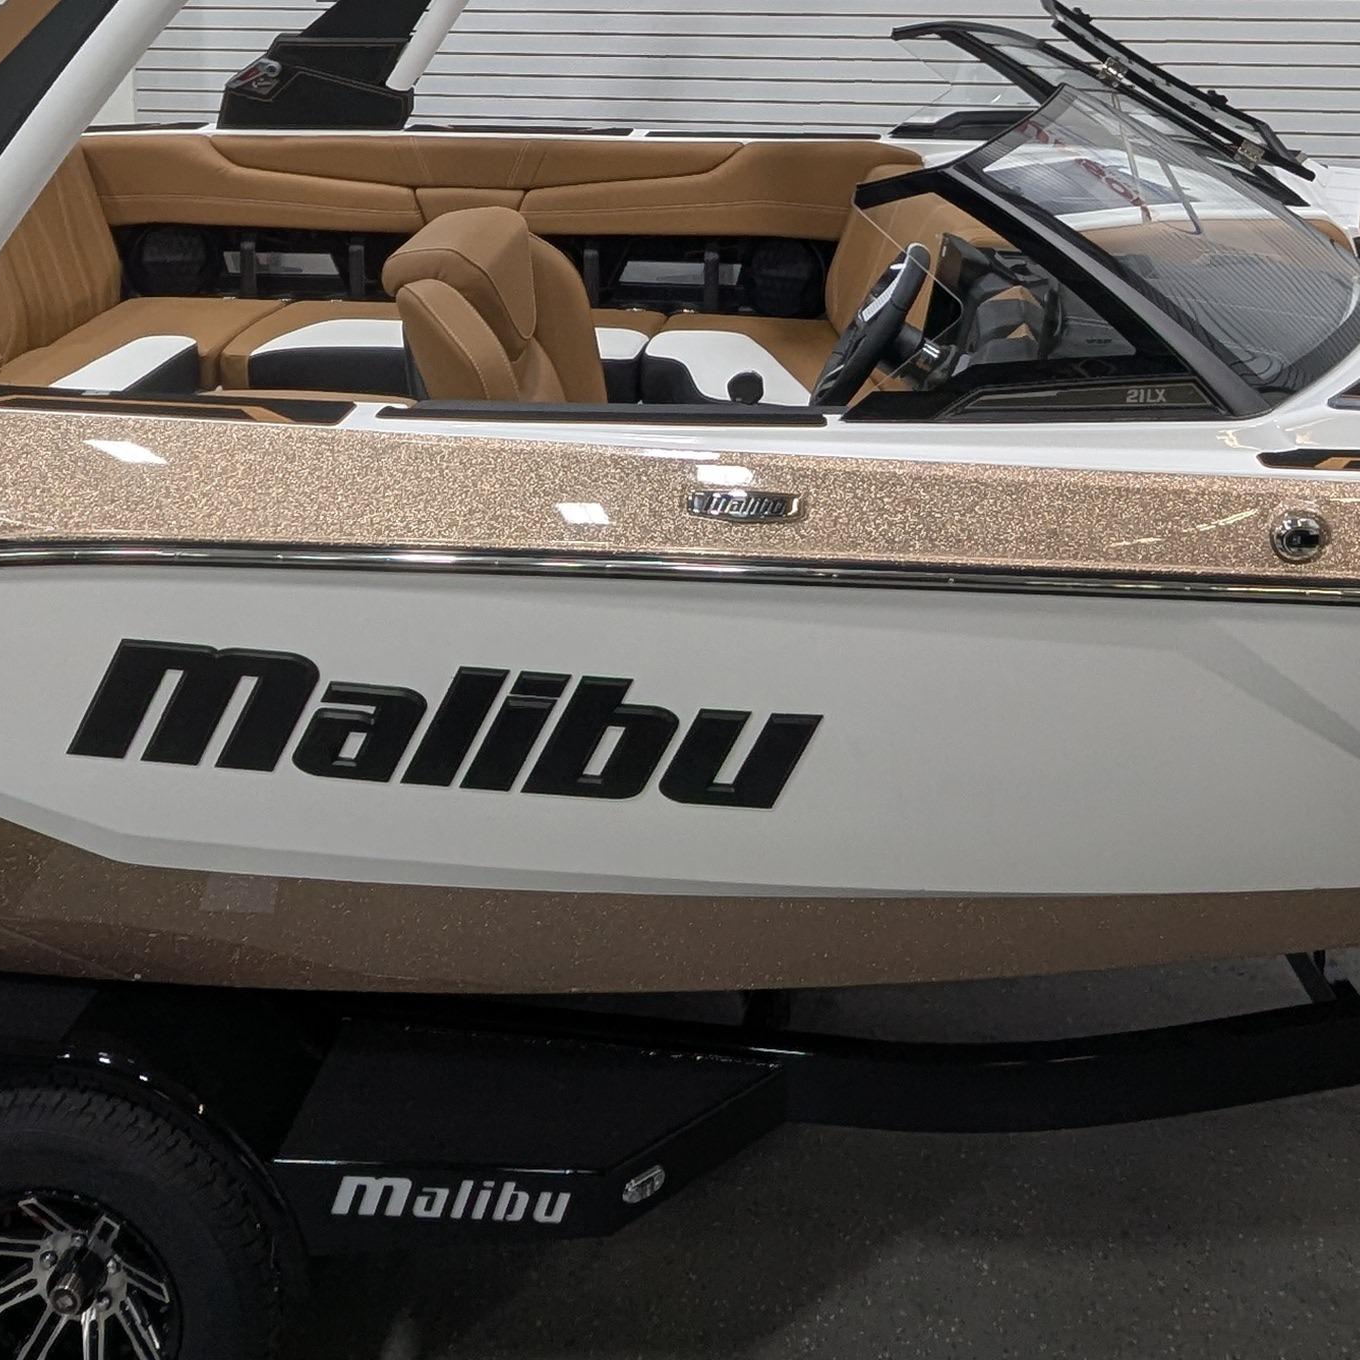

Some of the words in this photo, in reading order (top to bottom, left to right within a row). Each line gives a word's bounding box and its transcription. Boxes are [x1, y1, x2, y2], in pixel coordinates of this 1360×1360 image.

[1126, 389, 1167, 403] 21LX
[66, 638, 825, 810] Malibu
[331, 1176, 571, 1223] Malibu
